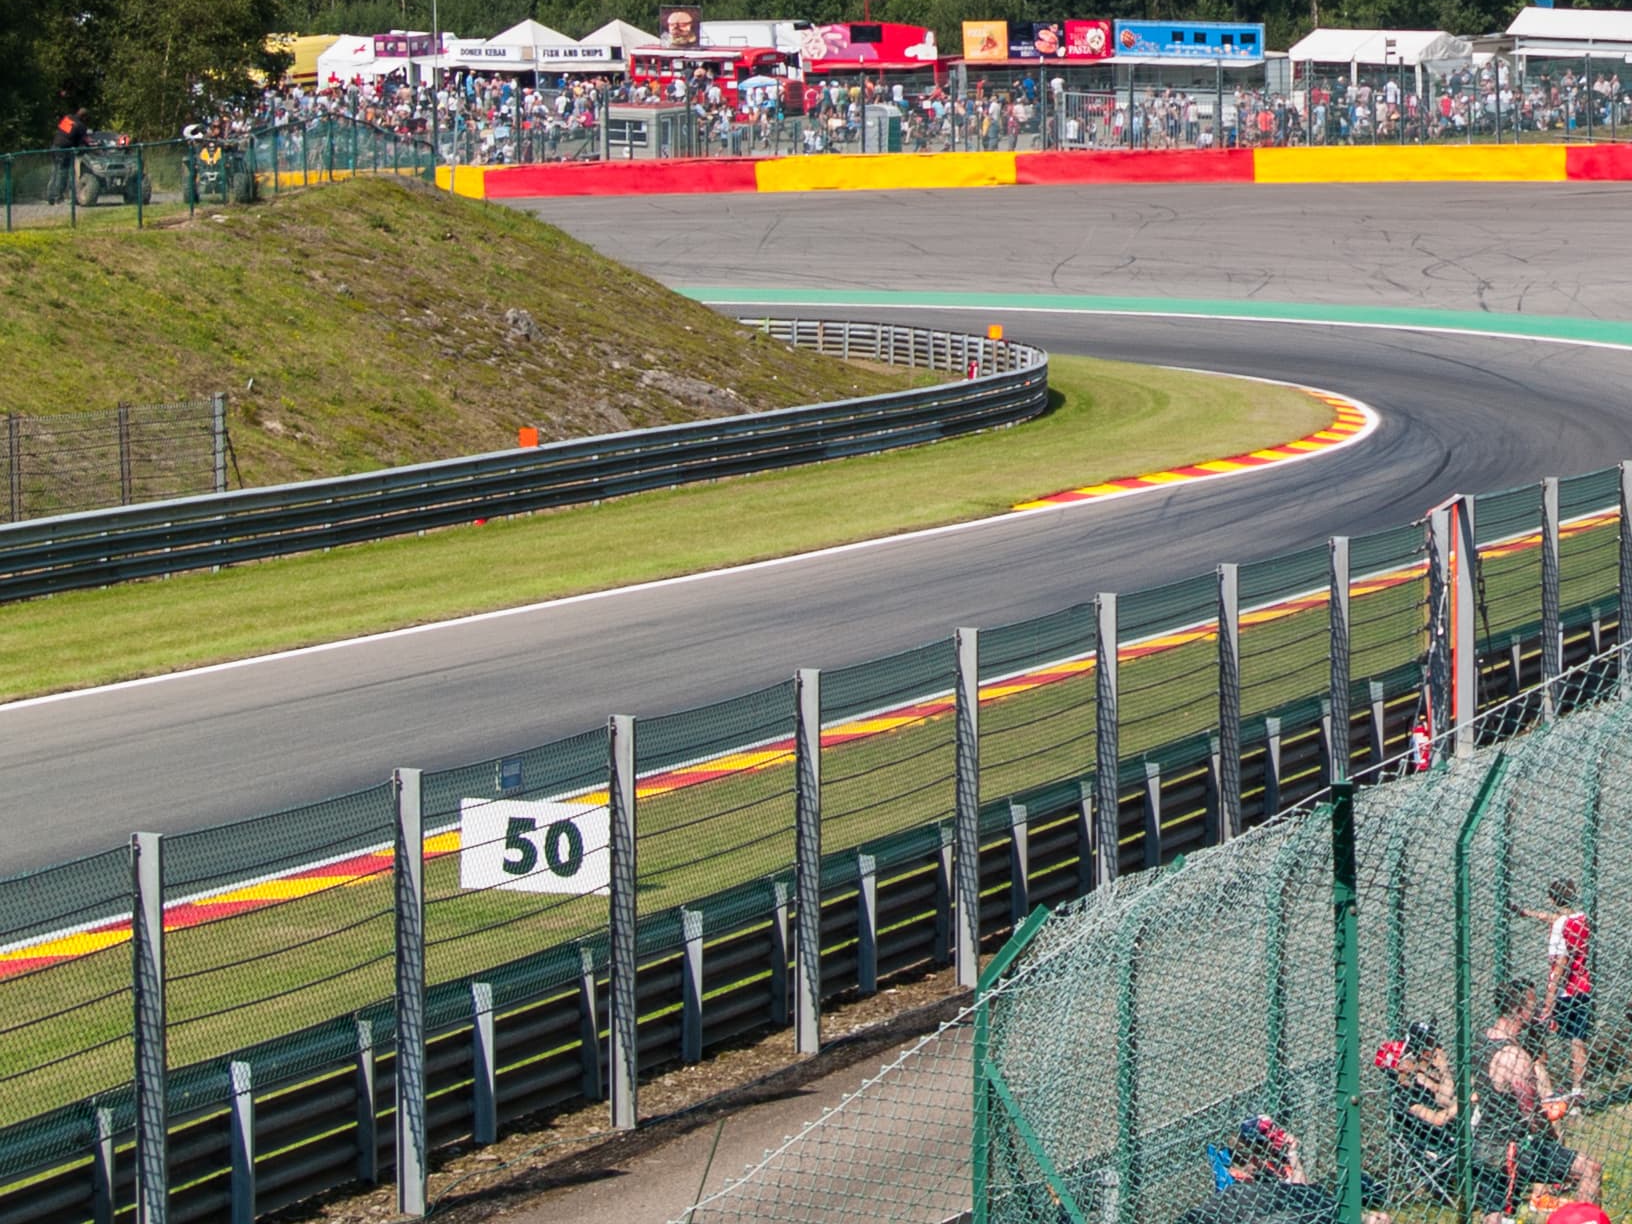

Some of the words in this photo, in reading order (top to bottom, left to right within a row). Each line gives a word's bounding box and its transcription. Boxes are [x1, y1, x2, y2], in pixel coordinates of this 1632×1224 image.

[485, 48, 506, 57] KEBAB
[543, 49, 559, 57] FISH
[563, 49, 578, 57] AND
[581, 49, 604, 57] CHIPS
[503, 817, 583, 877] 50
